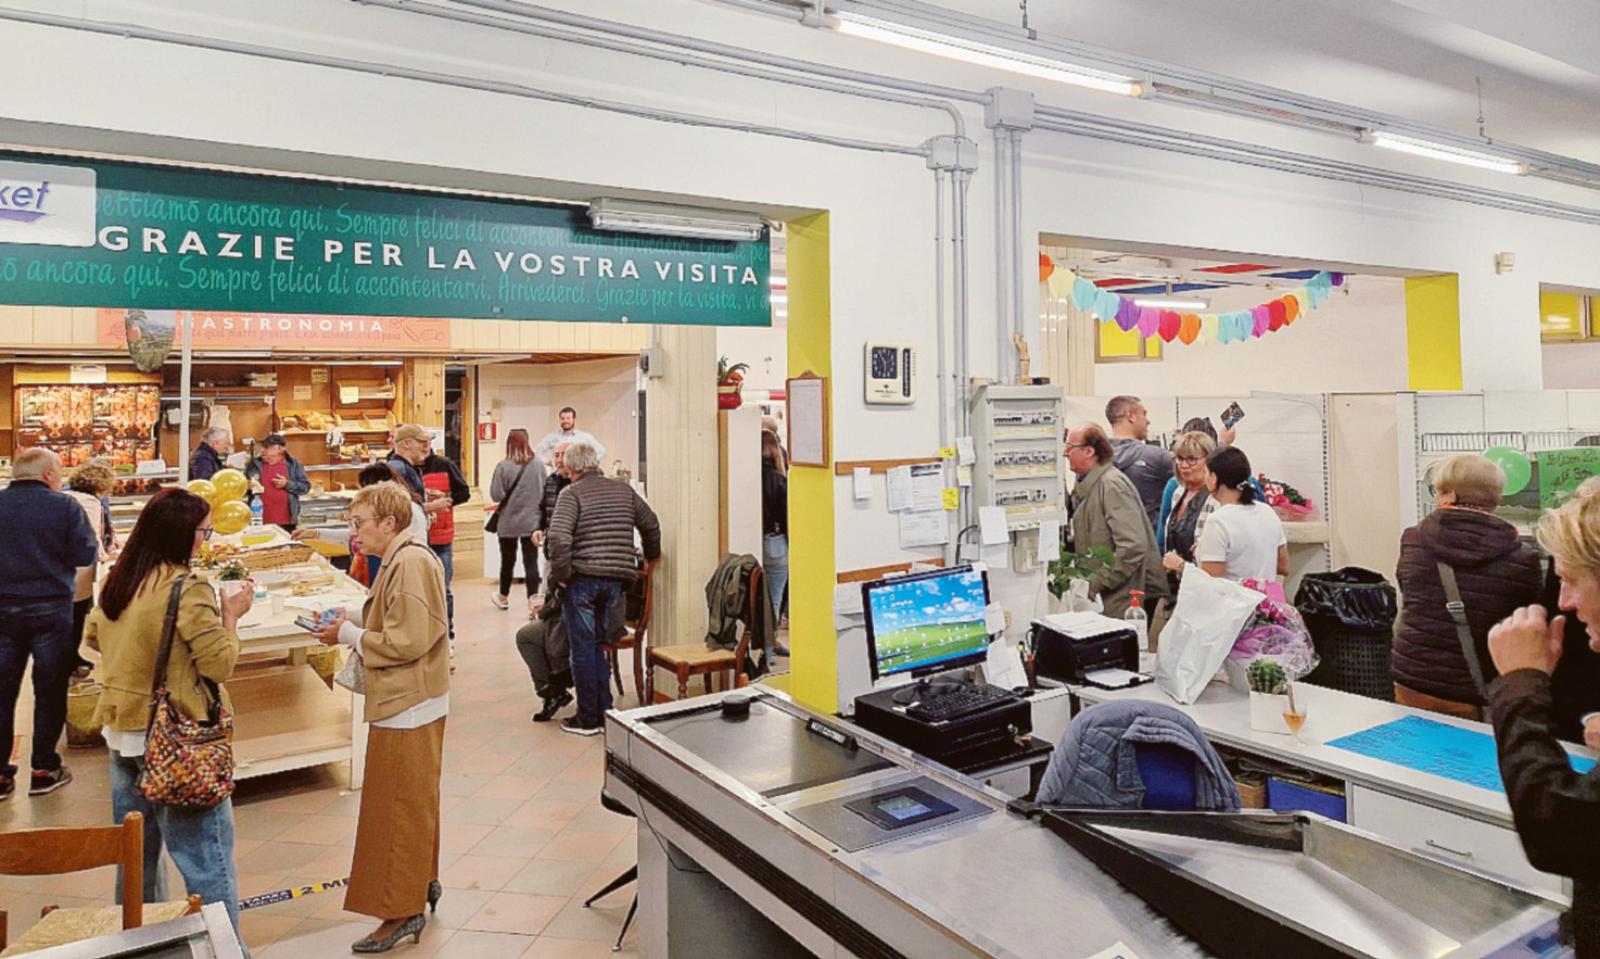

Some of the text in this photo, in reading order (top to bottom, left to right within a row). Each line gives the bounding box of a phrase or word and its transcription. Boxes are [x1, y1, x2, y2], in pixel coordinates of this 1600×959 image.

[98, 190, 200, 223] ettiamo
[207, 202, 283, 228] ancora
[289, 205, 329, 242] qui.
[335, 202, 409, 245] Sempre
[415, 208, 459, 247] felici
[466, 213, 484, 243] di
[98, 226, 758, 285] GRAZIE PER LA VOSTRA VISITA
[27, 259, 116, 285] ancora
[123, 256, 169, 300] qui.
[177, 256, 262, 301] Sempre
[268, 259, 322, 302] felici
[328, 262, 350, 294] di
[498, 272, 590, 304] Arrivederci.
[596, 277, 649, 311] Grazie
[652, 288, 674, 315] per
[678, 284, 694, 308] la
[300, 886, 314, 896] 2
